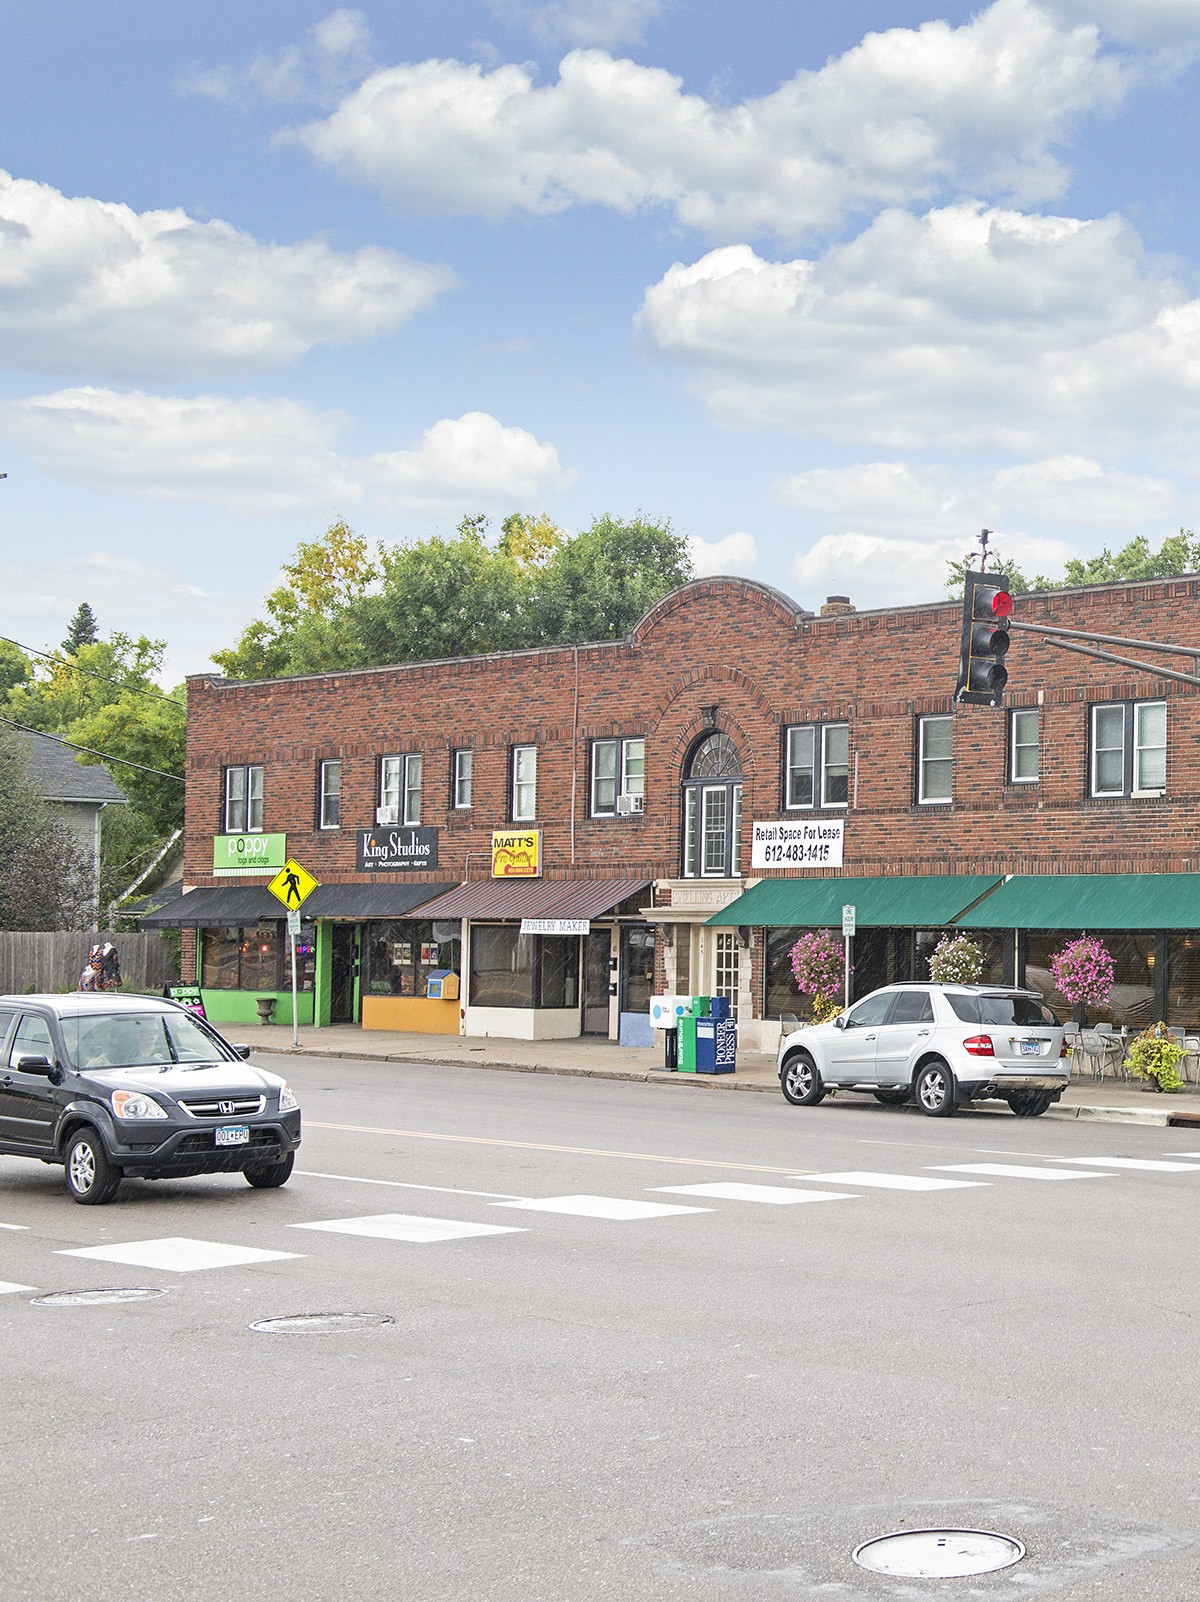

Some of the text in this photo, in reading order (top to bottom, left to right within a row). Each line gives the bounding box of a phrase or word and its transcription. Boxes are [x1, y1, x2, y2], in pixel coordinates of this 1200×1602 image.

[494, 836, 534, 848] MATT'S
[755, 825, 841, 843] Retail Space For Lease
[228, 838, 268, 858] poppy
[362, 831, 431, 861] King Studios
[765, 844, 829, 861] 612-483-1415
[248, 856, 257, 864] and
[673, 890, 711, 905] SNELLING
[522, 920, 588, 932] JEWELRY MAKER
[173, 988, 197, 996] poppy
[677, 1019, 685, 1065] StarTribune
[715, 1022, 727, 1065] PIONEER
[725, 1033, 735, 1065] PRESS
